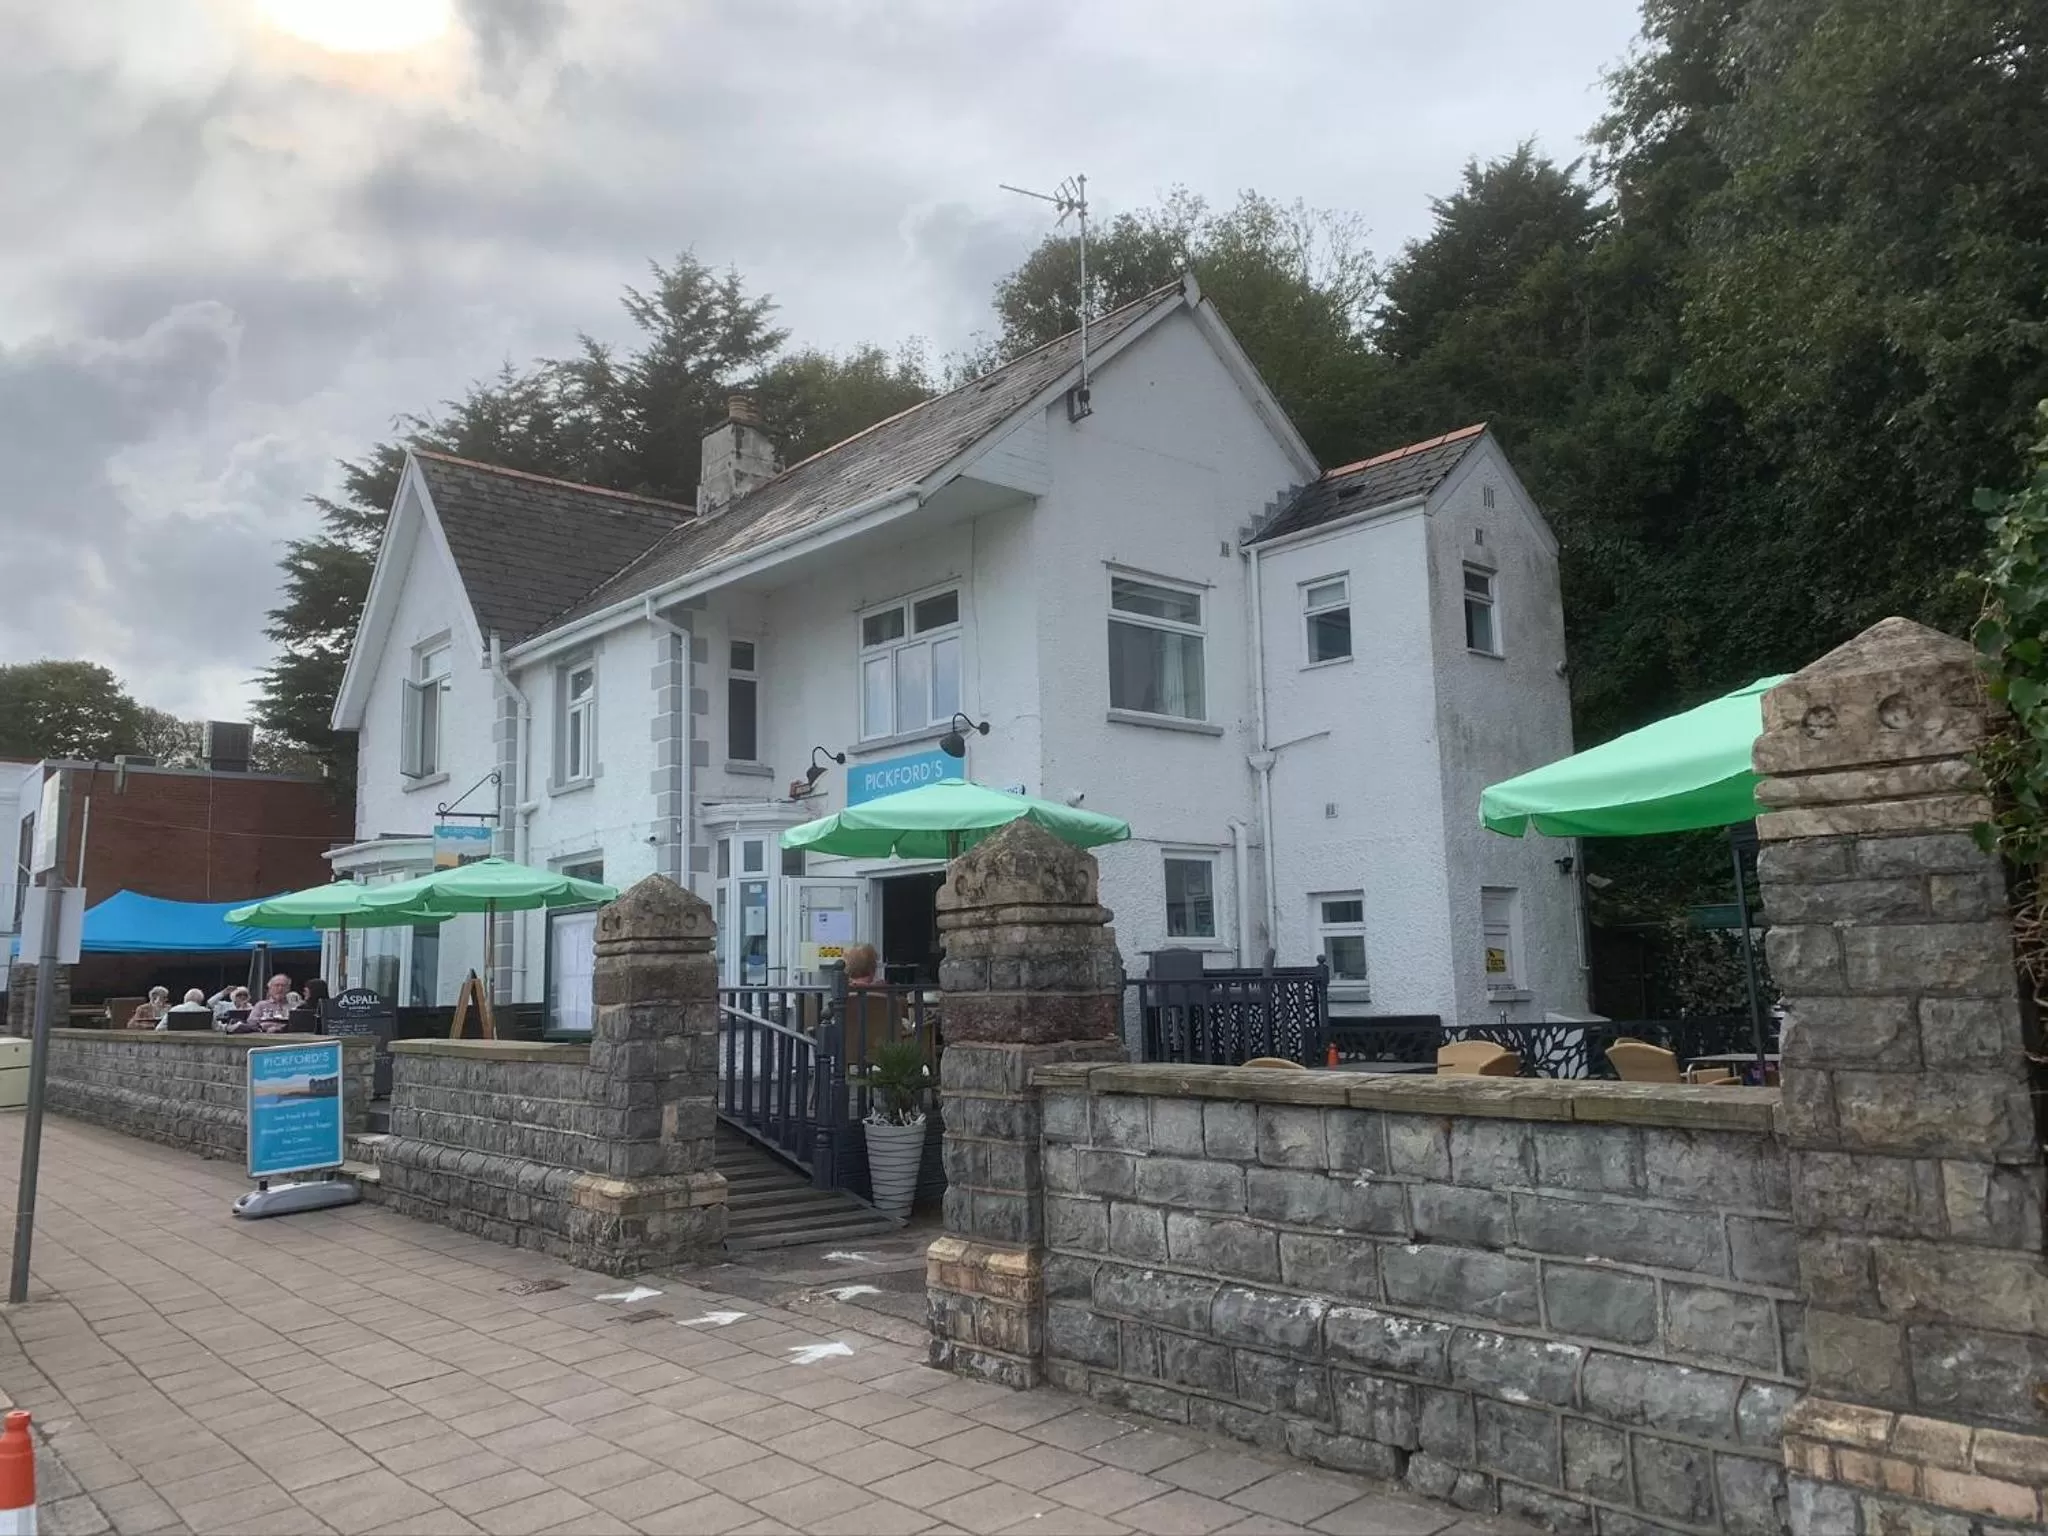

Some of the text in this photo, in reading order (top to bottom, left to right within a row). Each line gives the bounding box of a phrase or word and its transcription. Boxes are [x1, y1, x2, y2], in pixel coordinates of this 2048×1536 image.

[865, 760, 944, 791] PICKFORD'S
[338, 994, 381, 1008] ASPALL
[264, 1051, 329, 1067] PICKFORD'S
